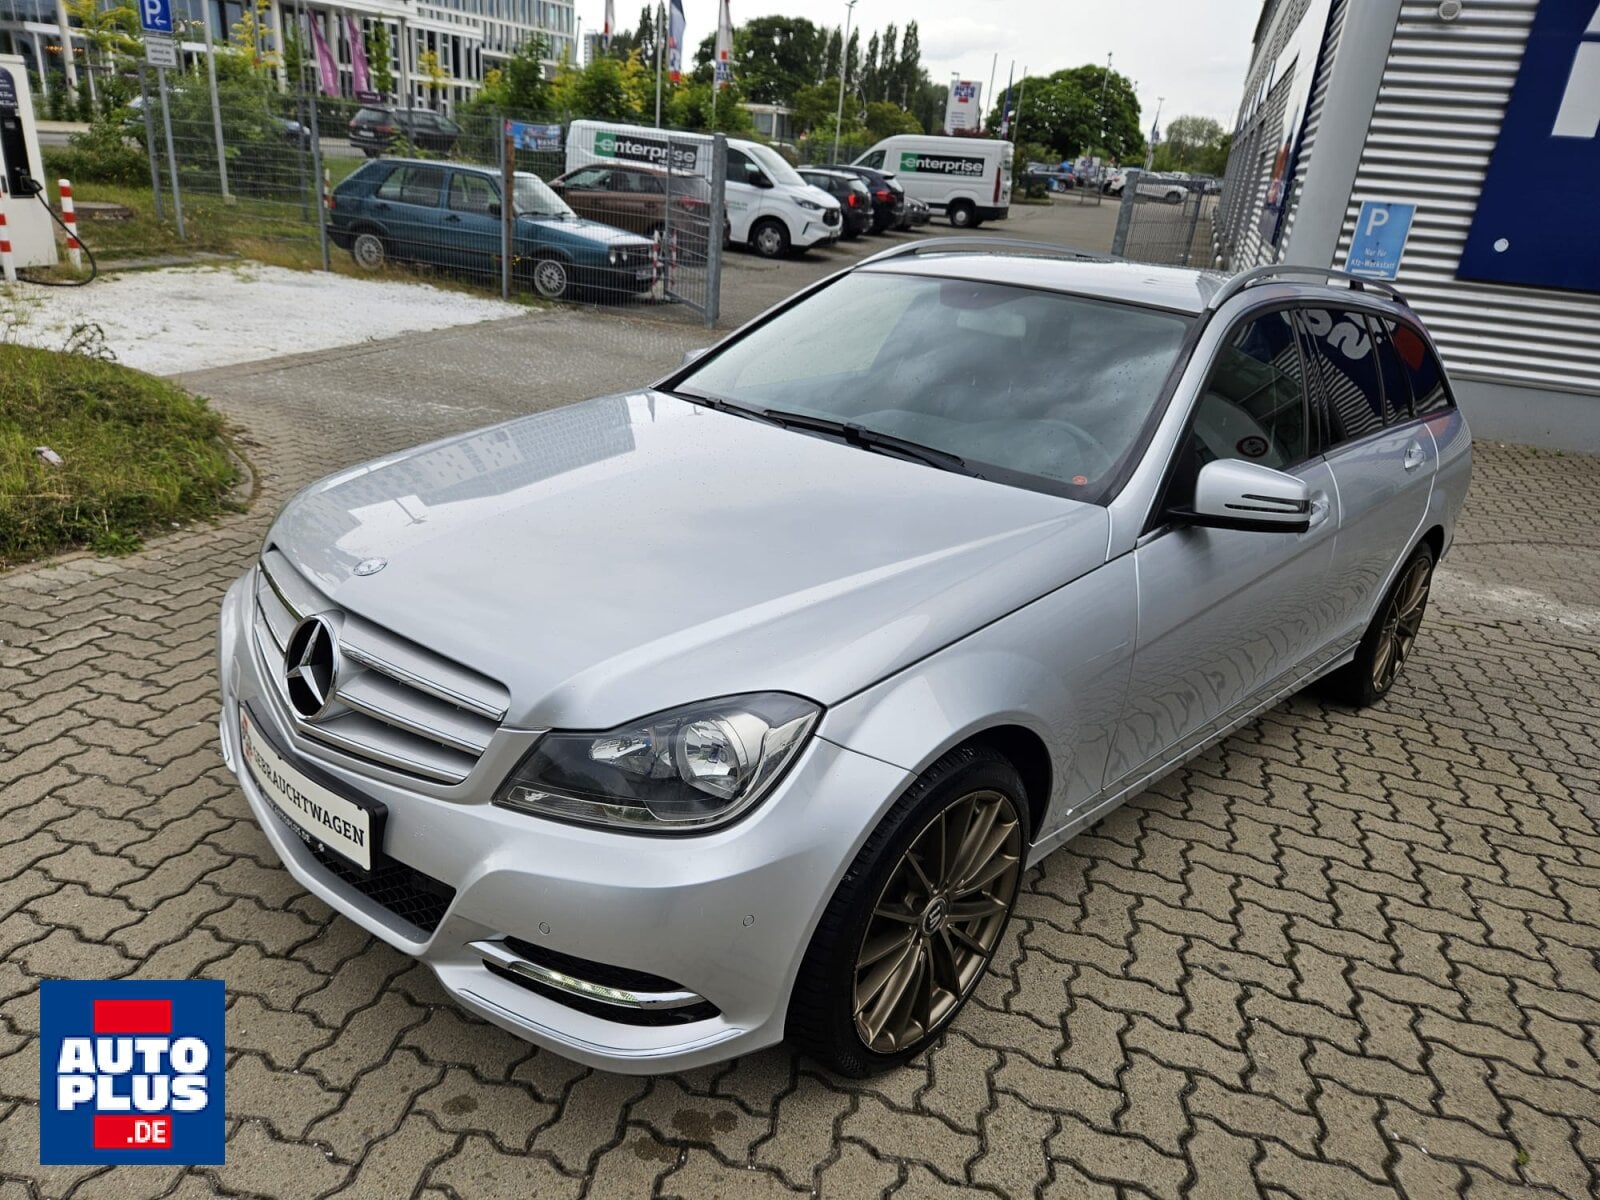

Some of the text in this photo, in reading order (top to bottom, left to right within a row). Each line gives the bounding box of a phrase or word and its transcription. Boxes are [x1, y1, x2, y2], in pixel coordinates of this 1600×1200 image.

[143, 0, 161, 25] P
[600, 138, 696, 163] enterprise
[905, 157, 983, 173] enterprise
[1365, 208, 1389, 236] P
[252, 746, 365, 848] GEBRAUCHTWAGEN
